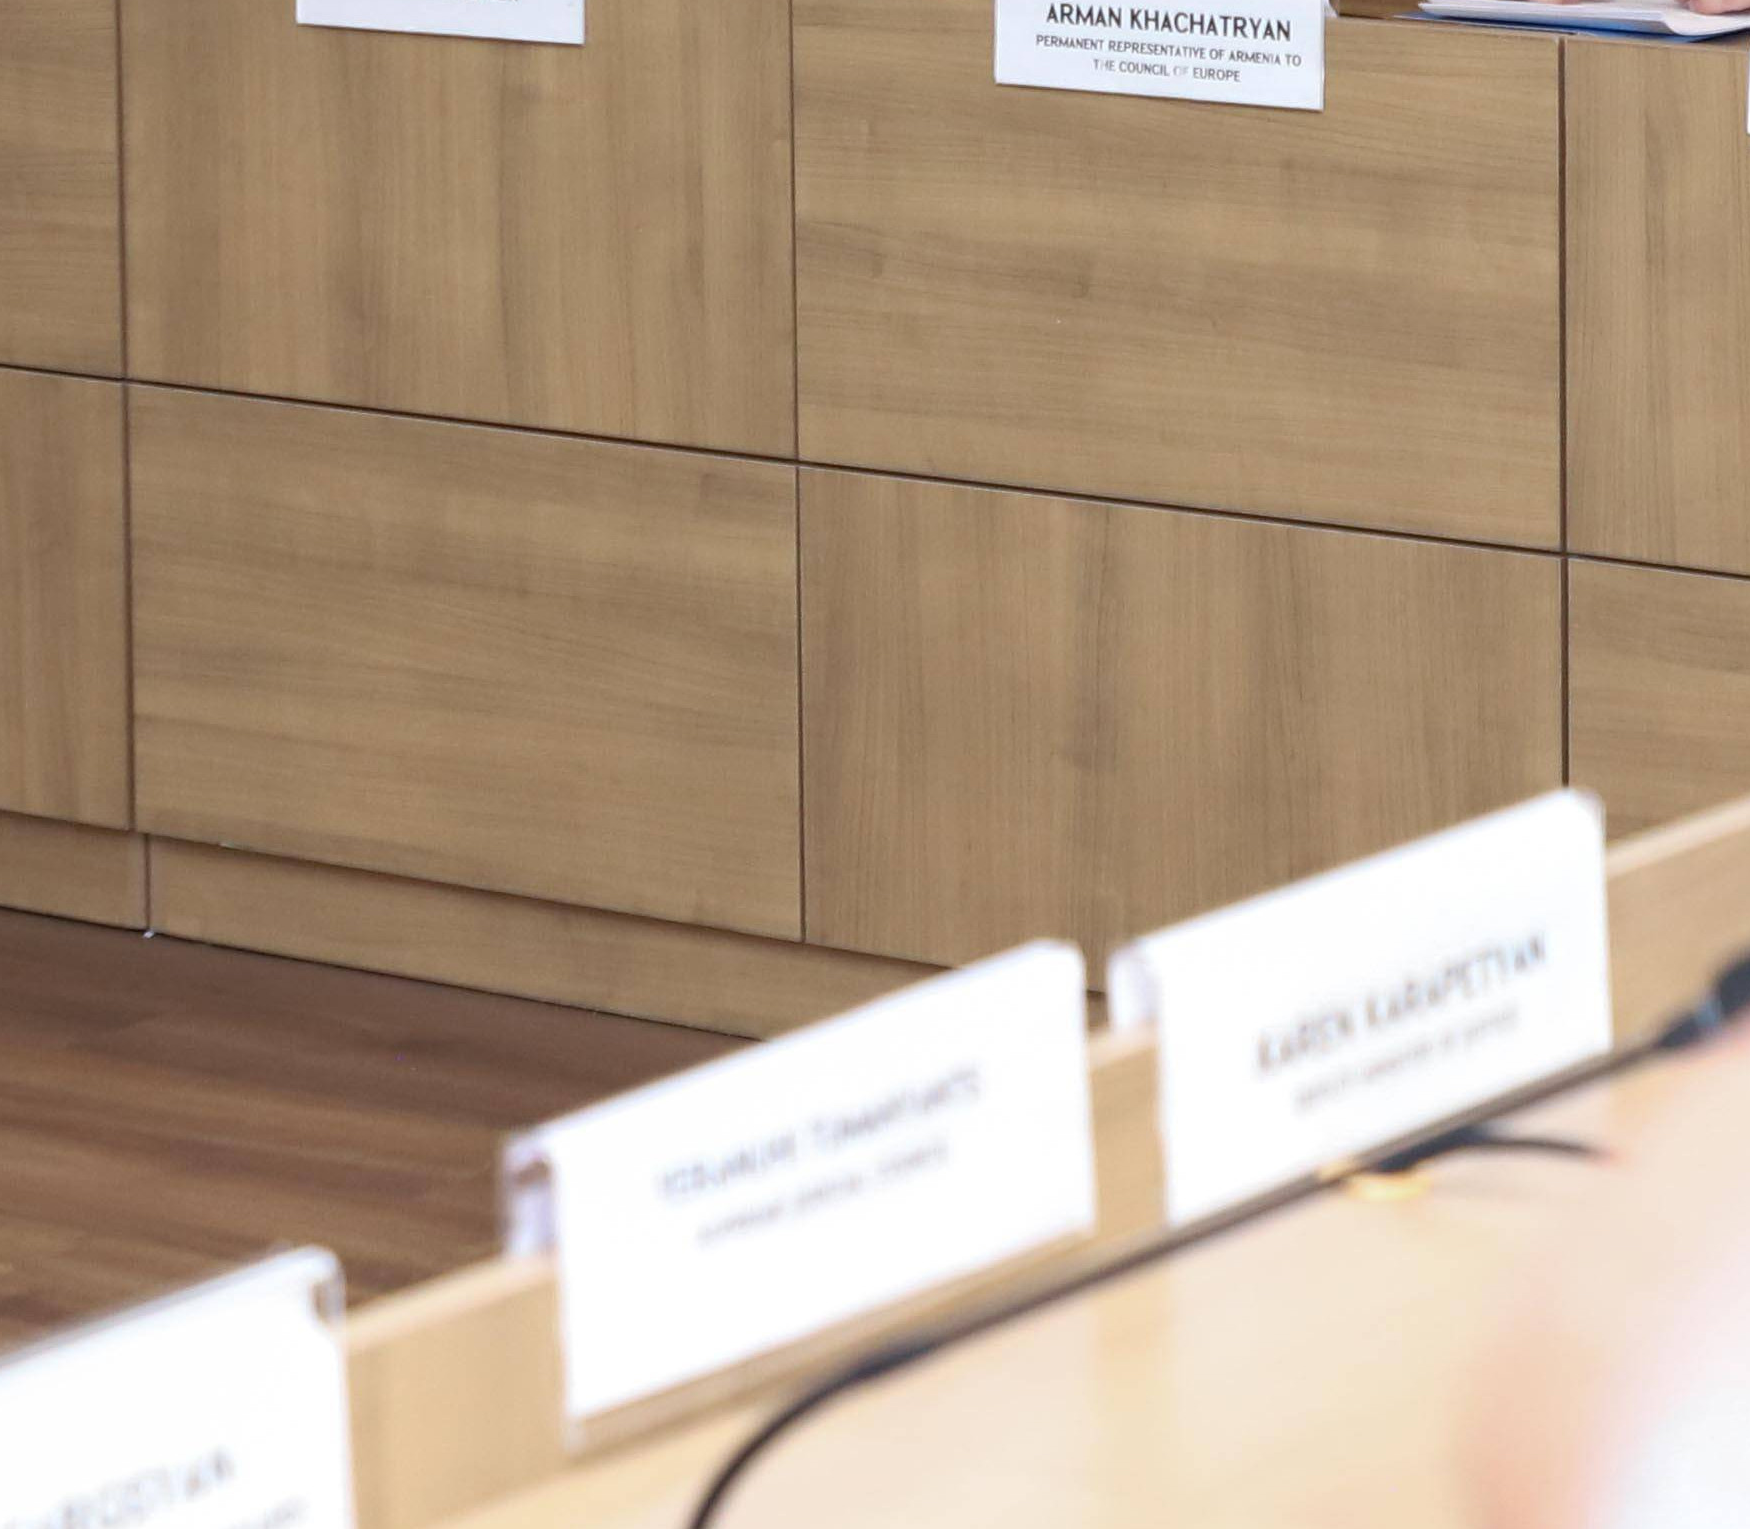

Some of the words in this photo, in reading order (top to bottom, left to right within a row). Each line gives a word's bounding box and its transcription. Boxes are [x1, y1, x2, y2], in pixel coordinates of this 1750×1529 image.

[1046, 2, 1123, 29] ARMAN
[1129, 8, 1292, 43] KHACHATRYAN
[1035, 34, 1105, 52] PERMANENT
[1107, 40, 1206, 61] REPRESENTATIVE
[1209, 47, 1226, 62] OF
[1228, 49, 1282, 67] ARMENIA
[1284, 53, 1302, 68] TO
[1092, 58, 1116, 72] THE
[1118, 60, 1170, 78] COUNCIL
[1192, 66, 1241, 83] EUROPE
